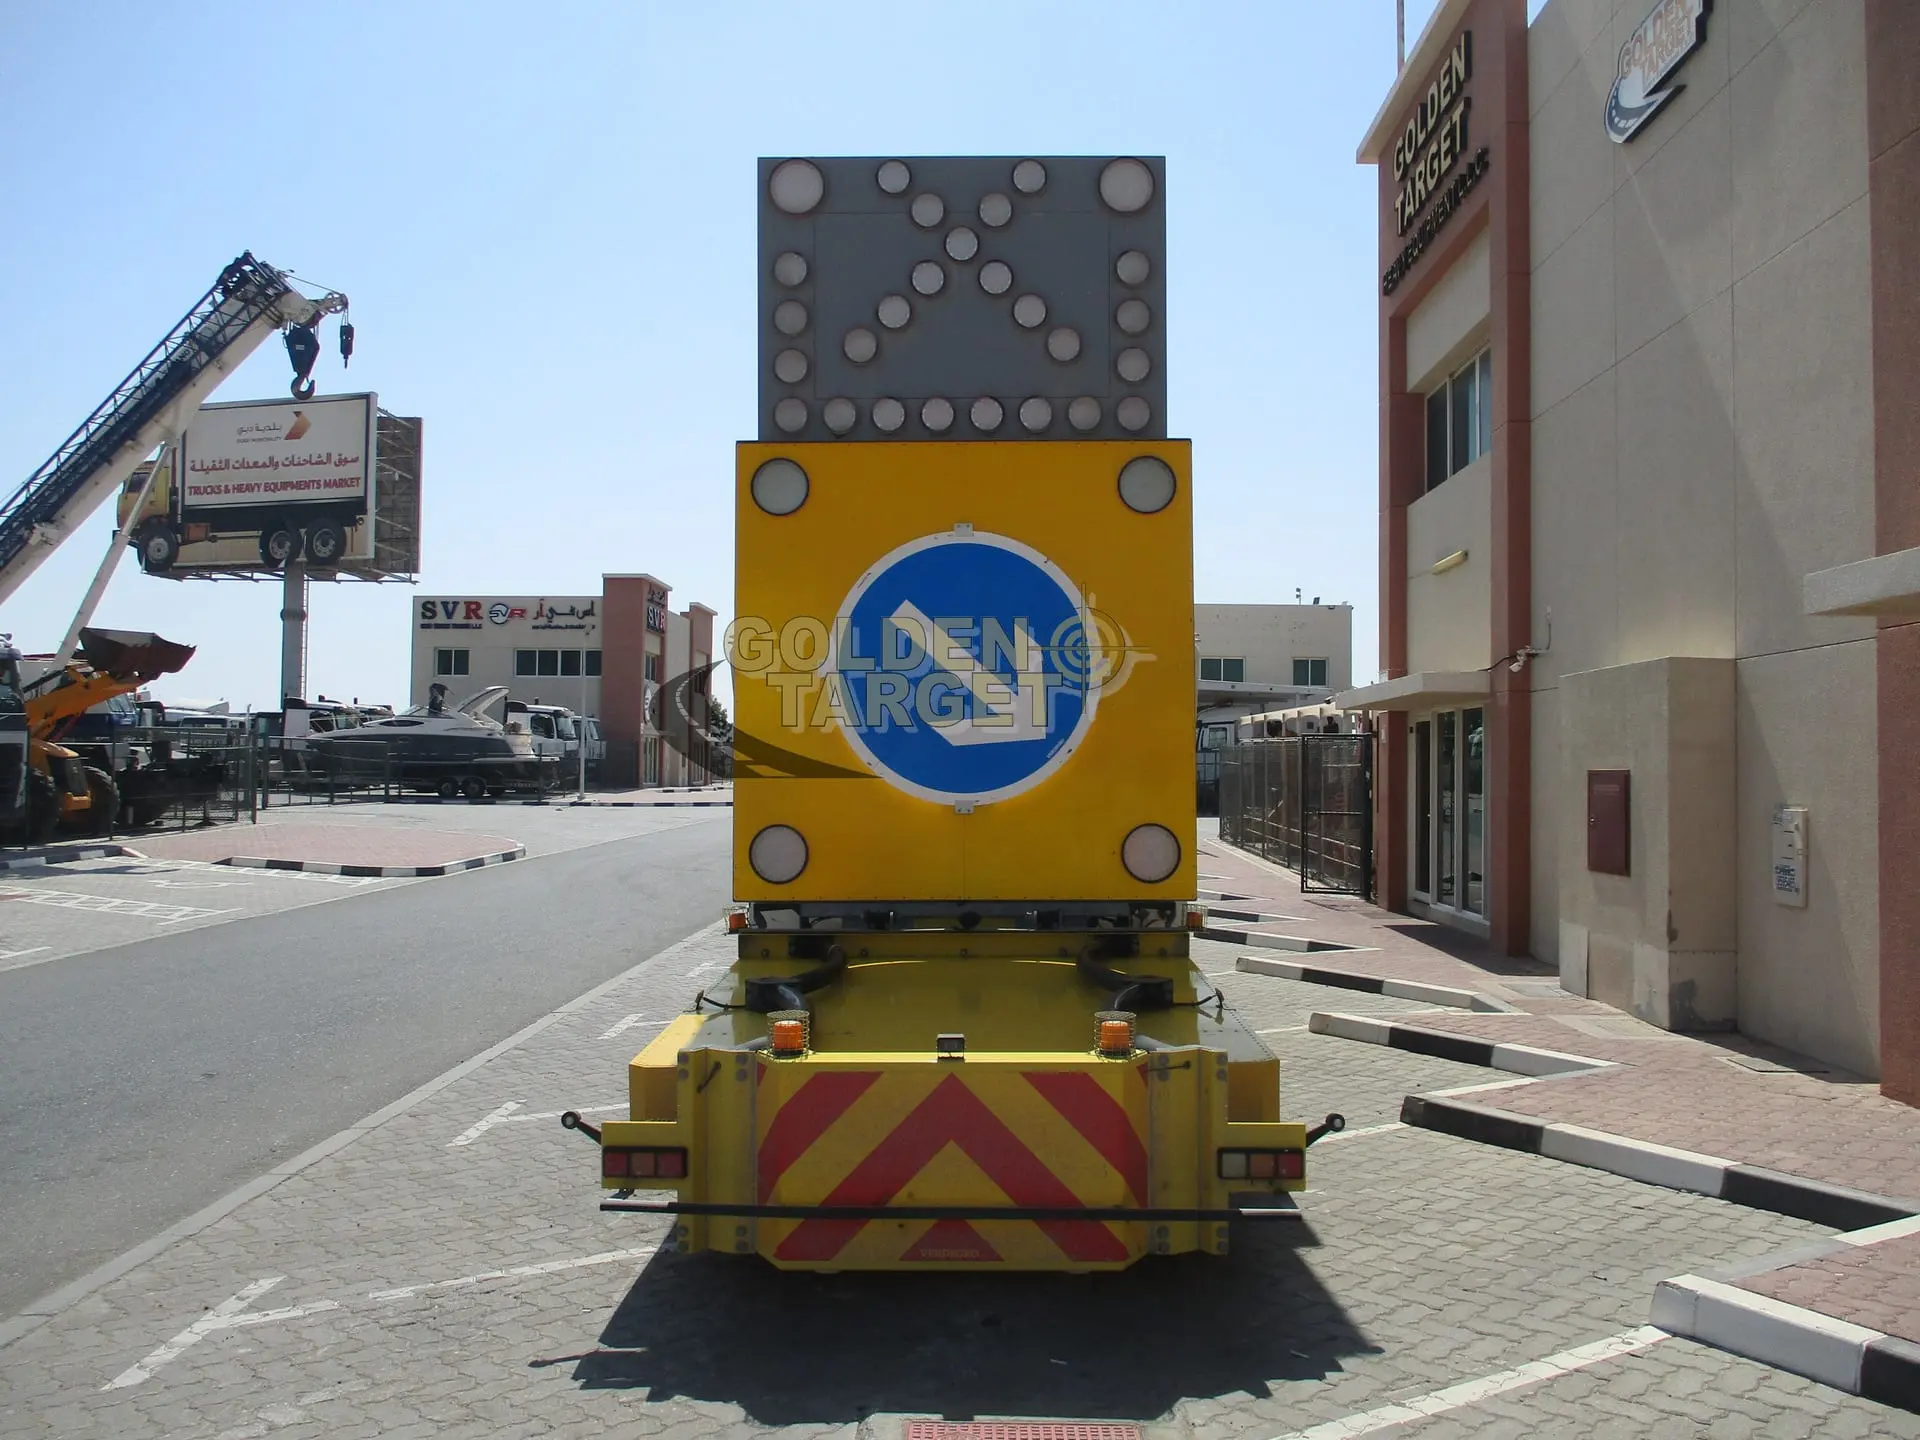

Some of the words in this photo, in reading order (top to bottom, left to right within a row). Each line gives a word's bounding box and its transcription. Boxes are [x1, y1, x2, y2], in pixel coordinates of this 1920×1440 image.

[1393, 30, 1469, 182] GOLDEN
[1394, 98, 1468, 236] TARGET
[189, 458, 230, 475] الثقيلة
[232, 455, 280, 470] والمعدات
[281, 452, 332, 467] الشاحنات
[333, 453, 360, 468] سوق
[188, 484, 222, 496] TRUCKS
[224, 484, 230, 494] &
[232, 482, 262, 494] HEAVY
[264, 479, 321, 493] EQUIPMENTS
[323, 477, 361, 489] MARKET
[421, 600, 484, 620] SVR
[647, 606, 666, 630] SVR
